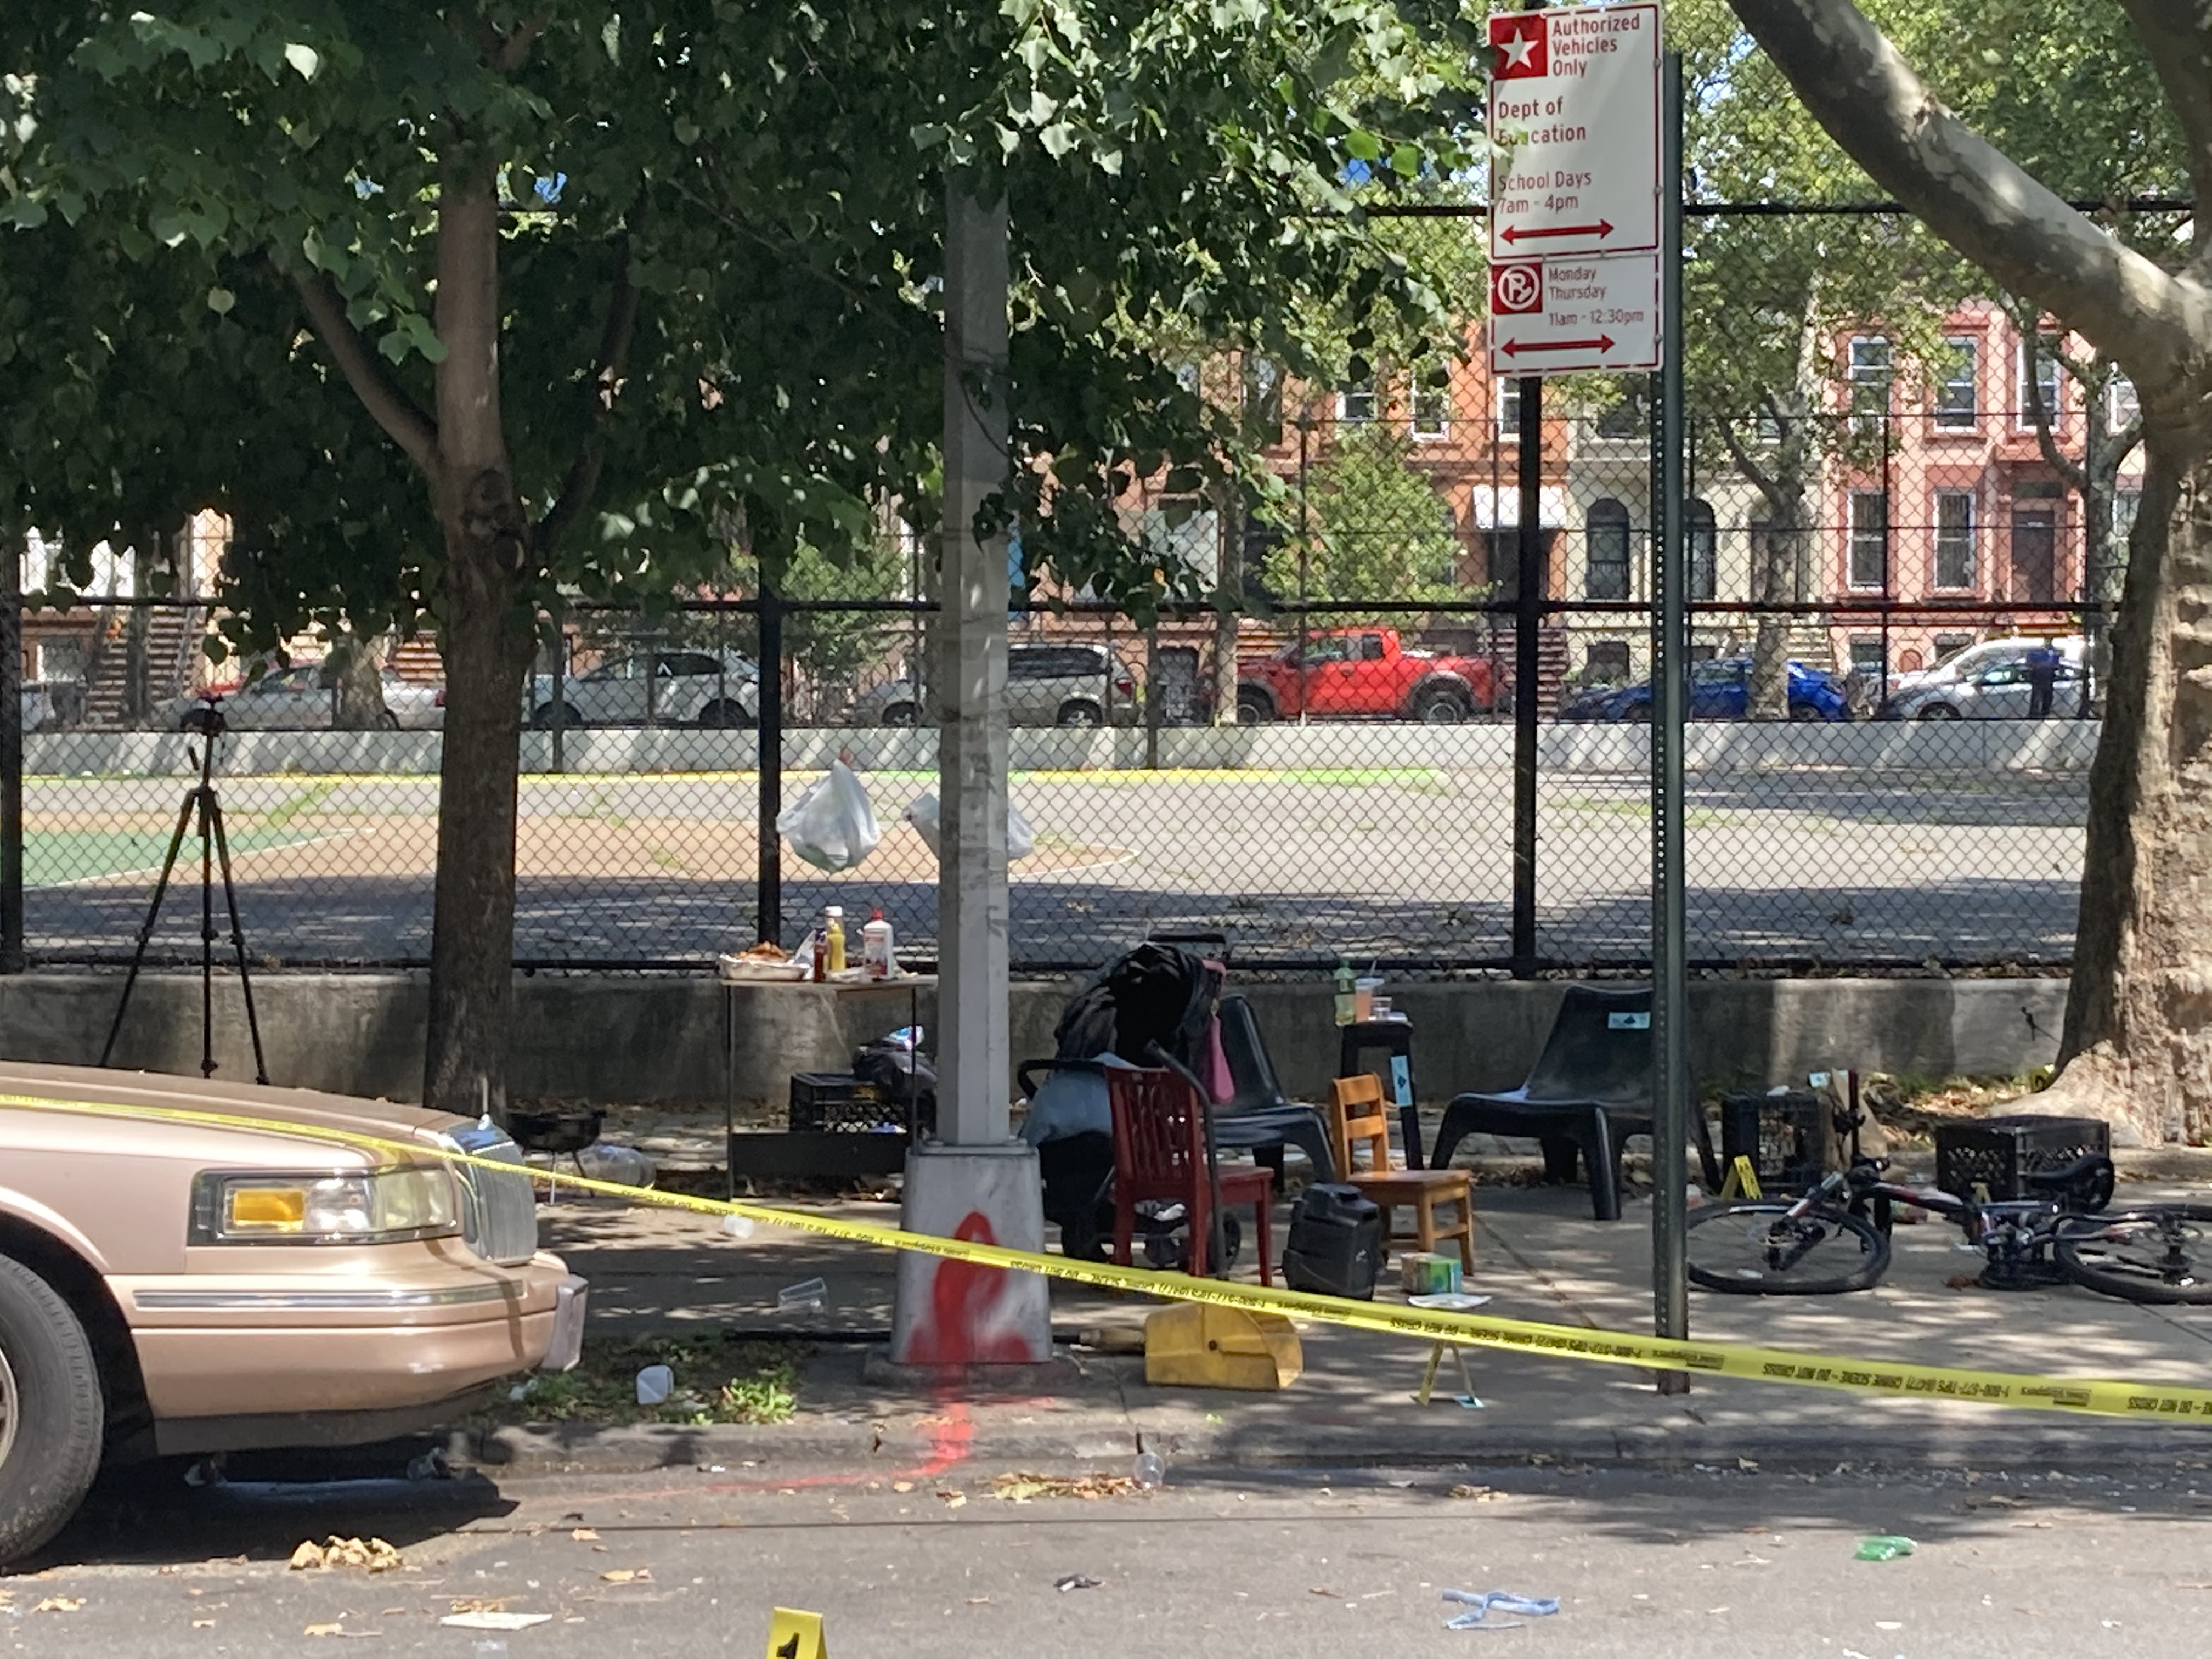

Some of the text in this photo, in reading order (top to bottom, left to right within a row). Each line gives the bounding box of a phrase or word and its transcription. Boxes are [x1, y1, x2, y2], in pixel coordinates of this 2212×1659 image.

[1553, 14, 1640, 36] Authorized
[1552, 37, 1617, 57] Vehicles
[1553, 59, 1588, 77] Only
[1498, 97, 1563, 121] Dept of
[1498, 171, 1592, 191] School Days
[1498, 198, 1529, 214] 7am
[1544, 194, 1579, 215] 4pm
[1548, 267, 1596, 283] Monday
[1549, 285, 1606, 301] Thursday
[1549, 312, 1577, 326] 11am
[1590, 308, 1644, 326] 12:30pm
